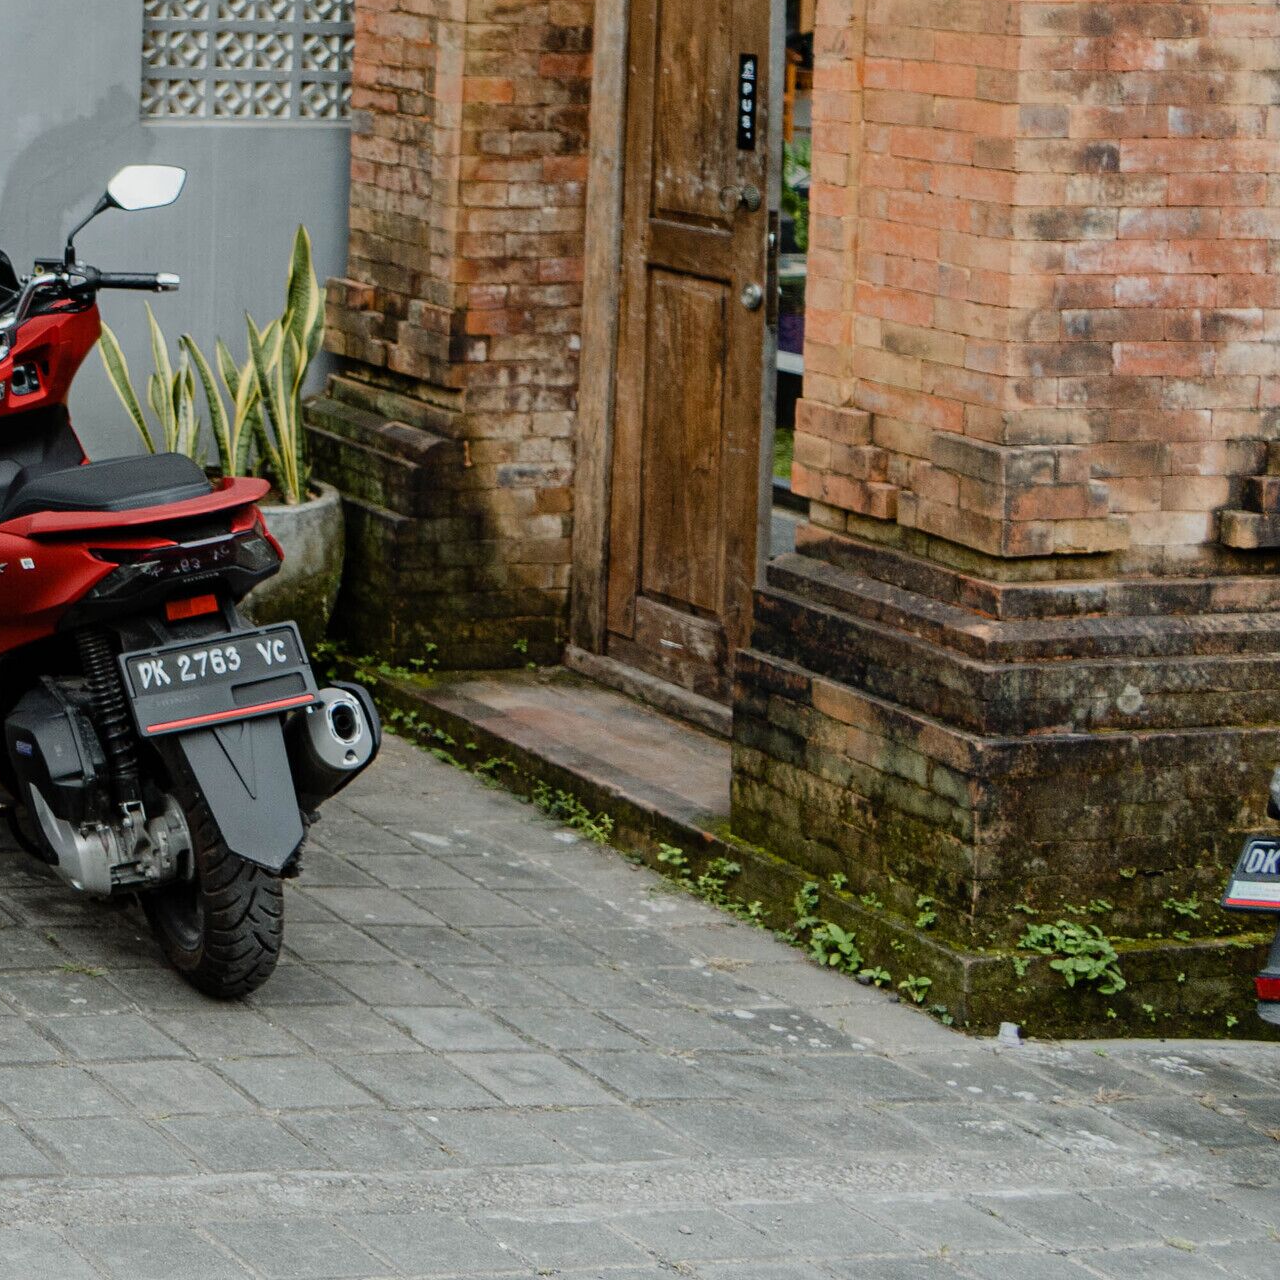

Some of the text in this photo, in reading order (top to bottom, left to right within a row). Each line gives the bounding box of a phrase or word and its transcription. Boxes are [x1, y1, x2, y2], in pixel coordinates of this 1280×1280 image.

[138, 639, 287, 689] DK 2763 VC
[1245, 848, 1280, 873] DK
